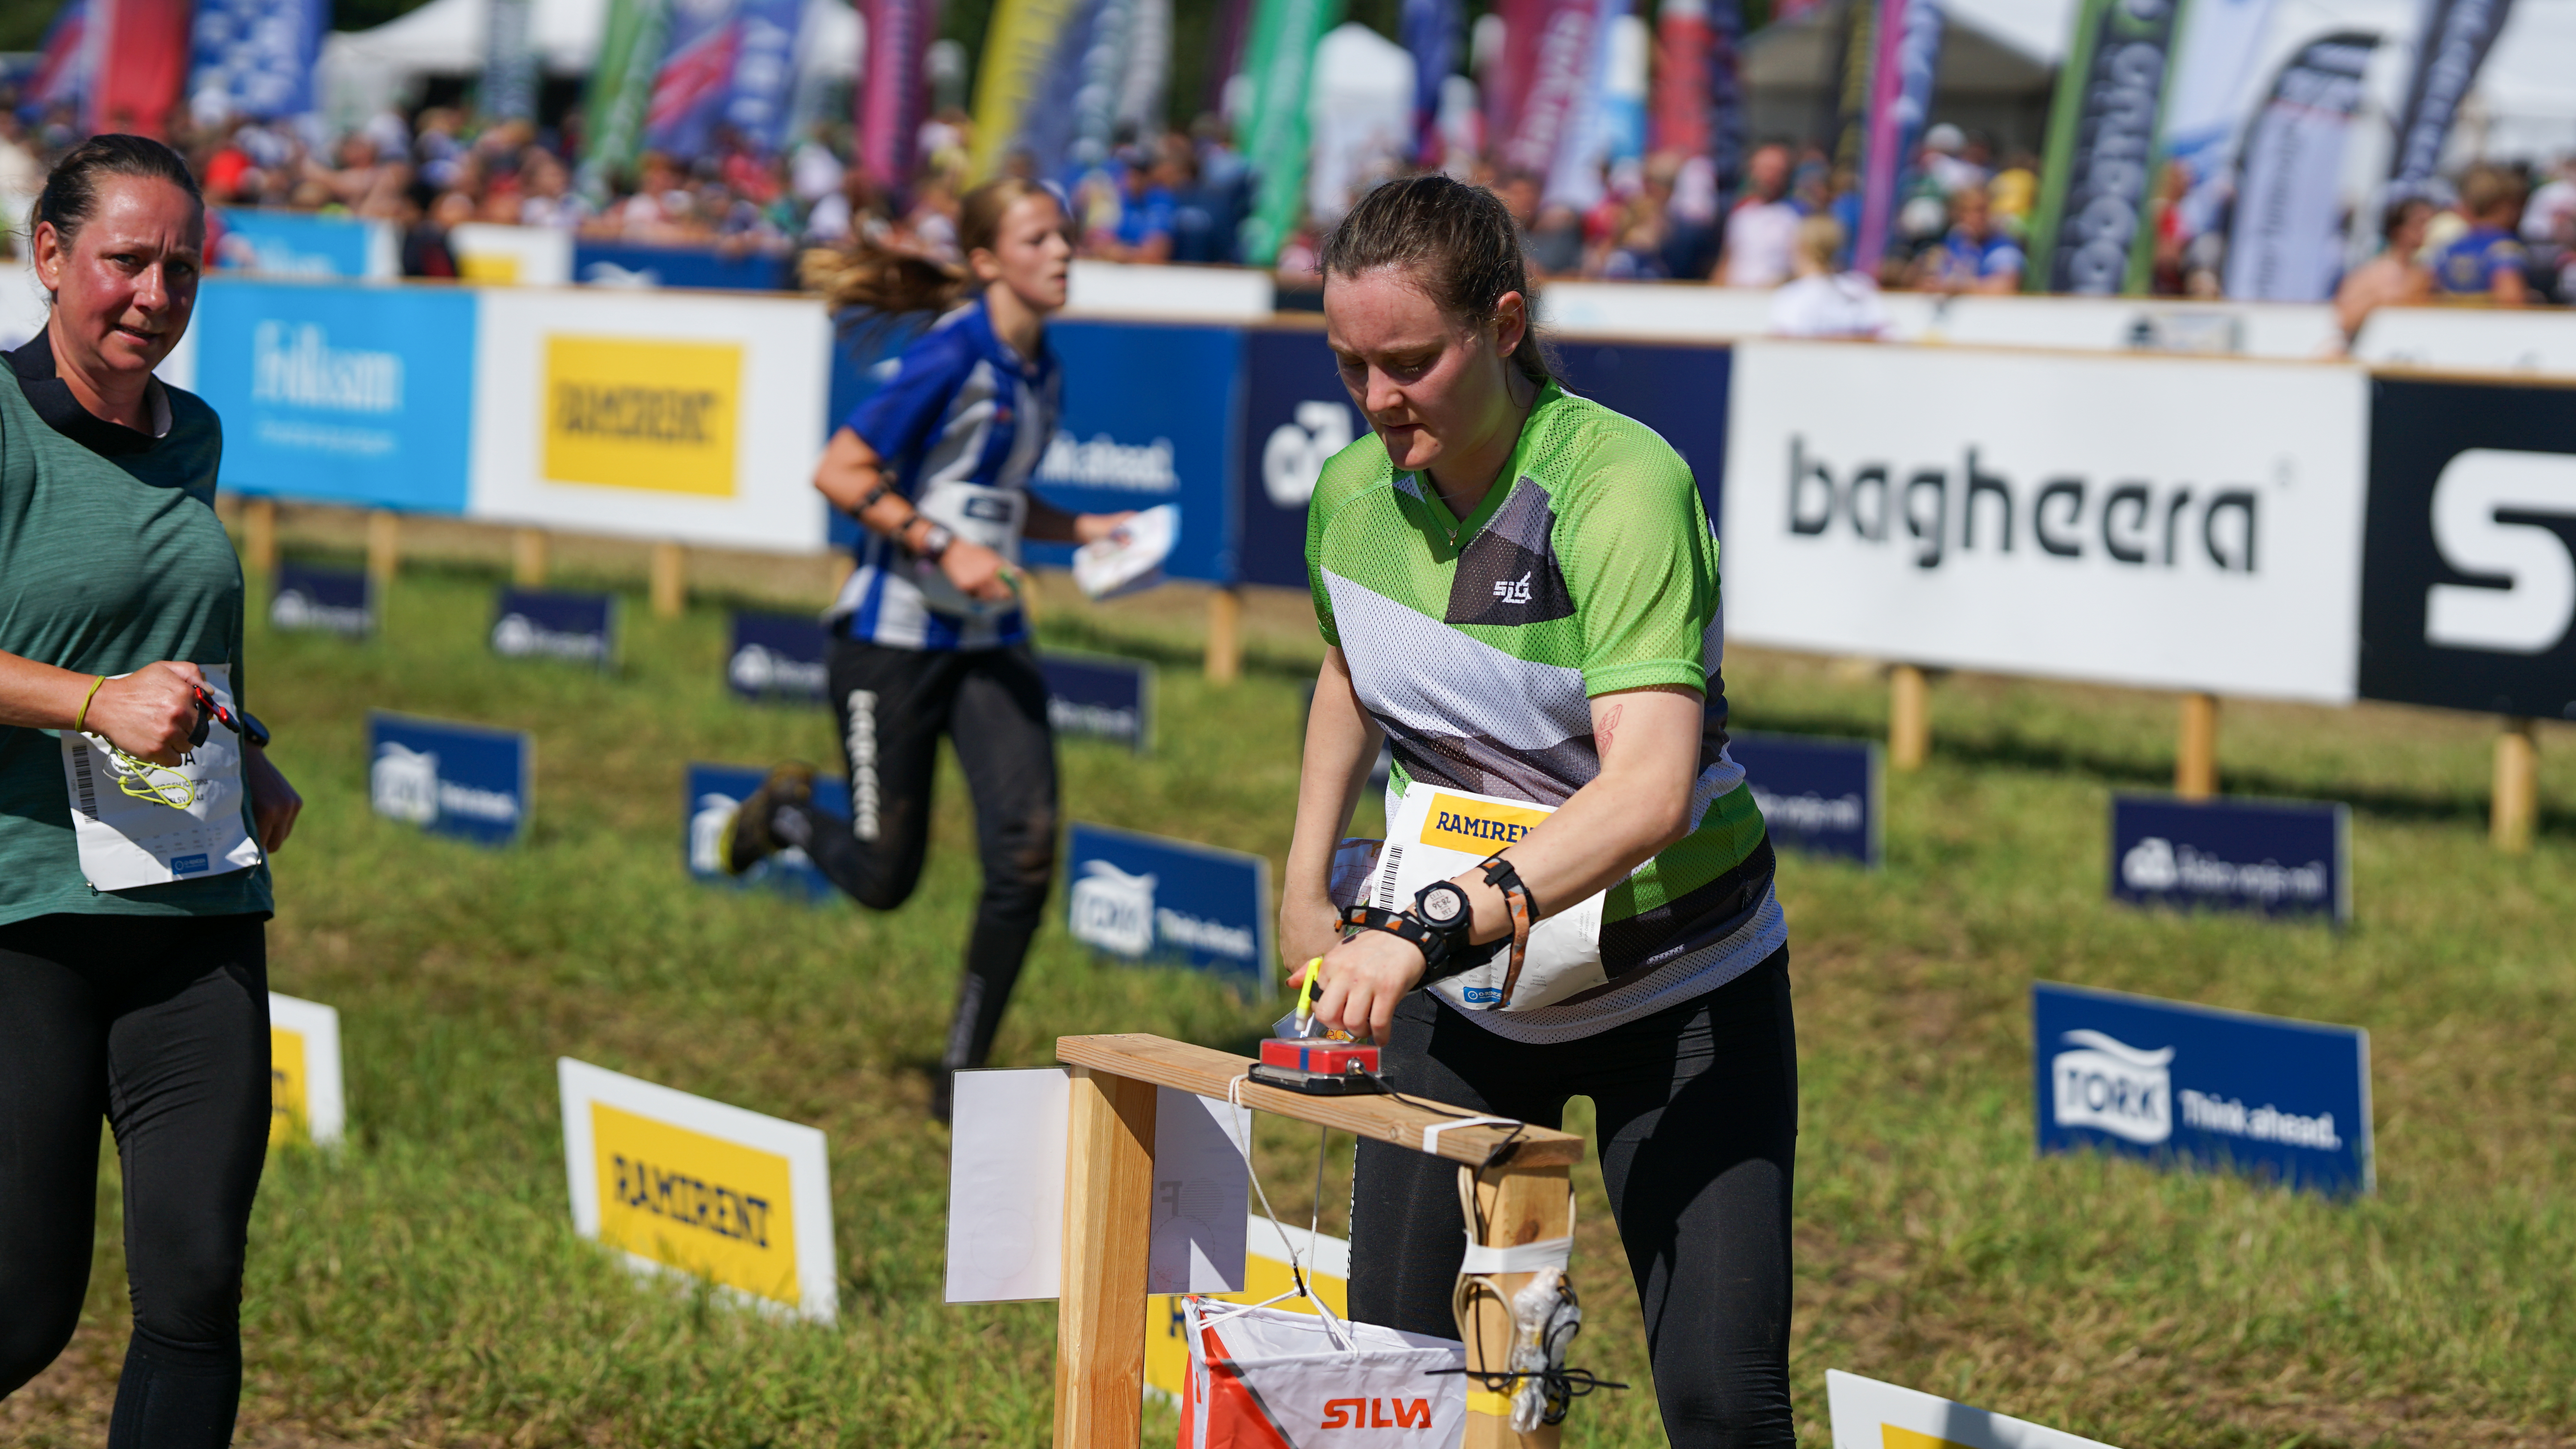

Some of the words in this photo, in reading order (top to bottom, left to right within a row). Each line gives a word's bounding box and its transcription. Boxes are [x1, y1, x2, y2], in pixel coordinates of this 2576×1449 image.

[1788, 433, 2258, 573] bagheera
[1436, 811, 1534, 843] RAMIREN
[2066, 1069, 2161, 1125] TORK
[2178, 1087, 2249, 1134] Think
[2249, 1103, 2342, 1152] ahead.
[611, 1154, 771, 1249] RAMIRENT
[1321, 1397, 1433, 1430] SILVA
